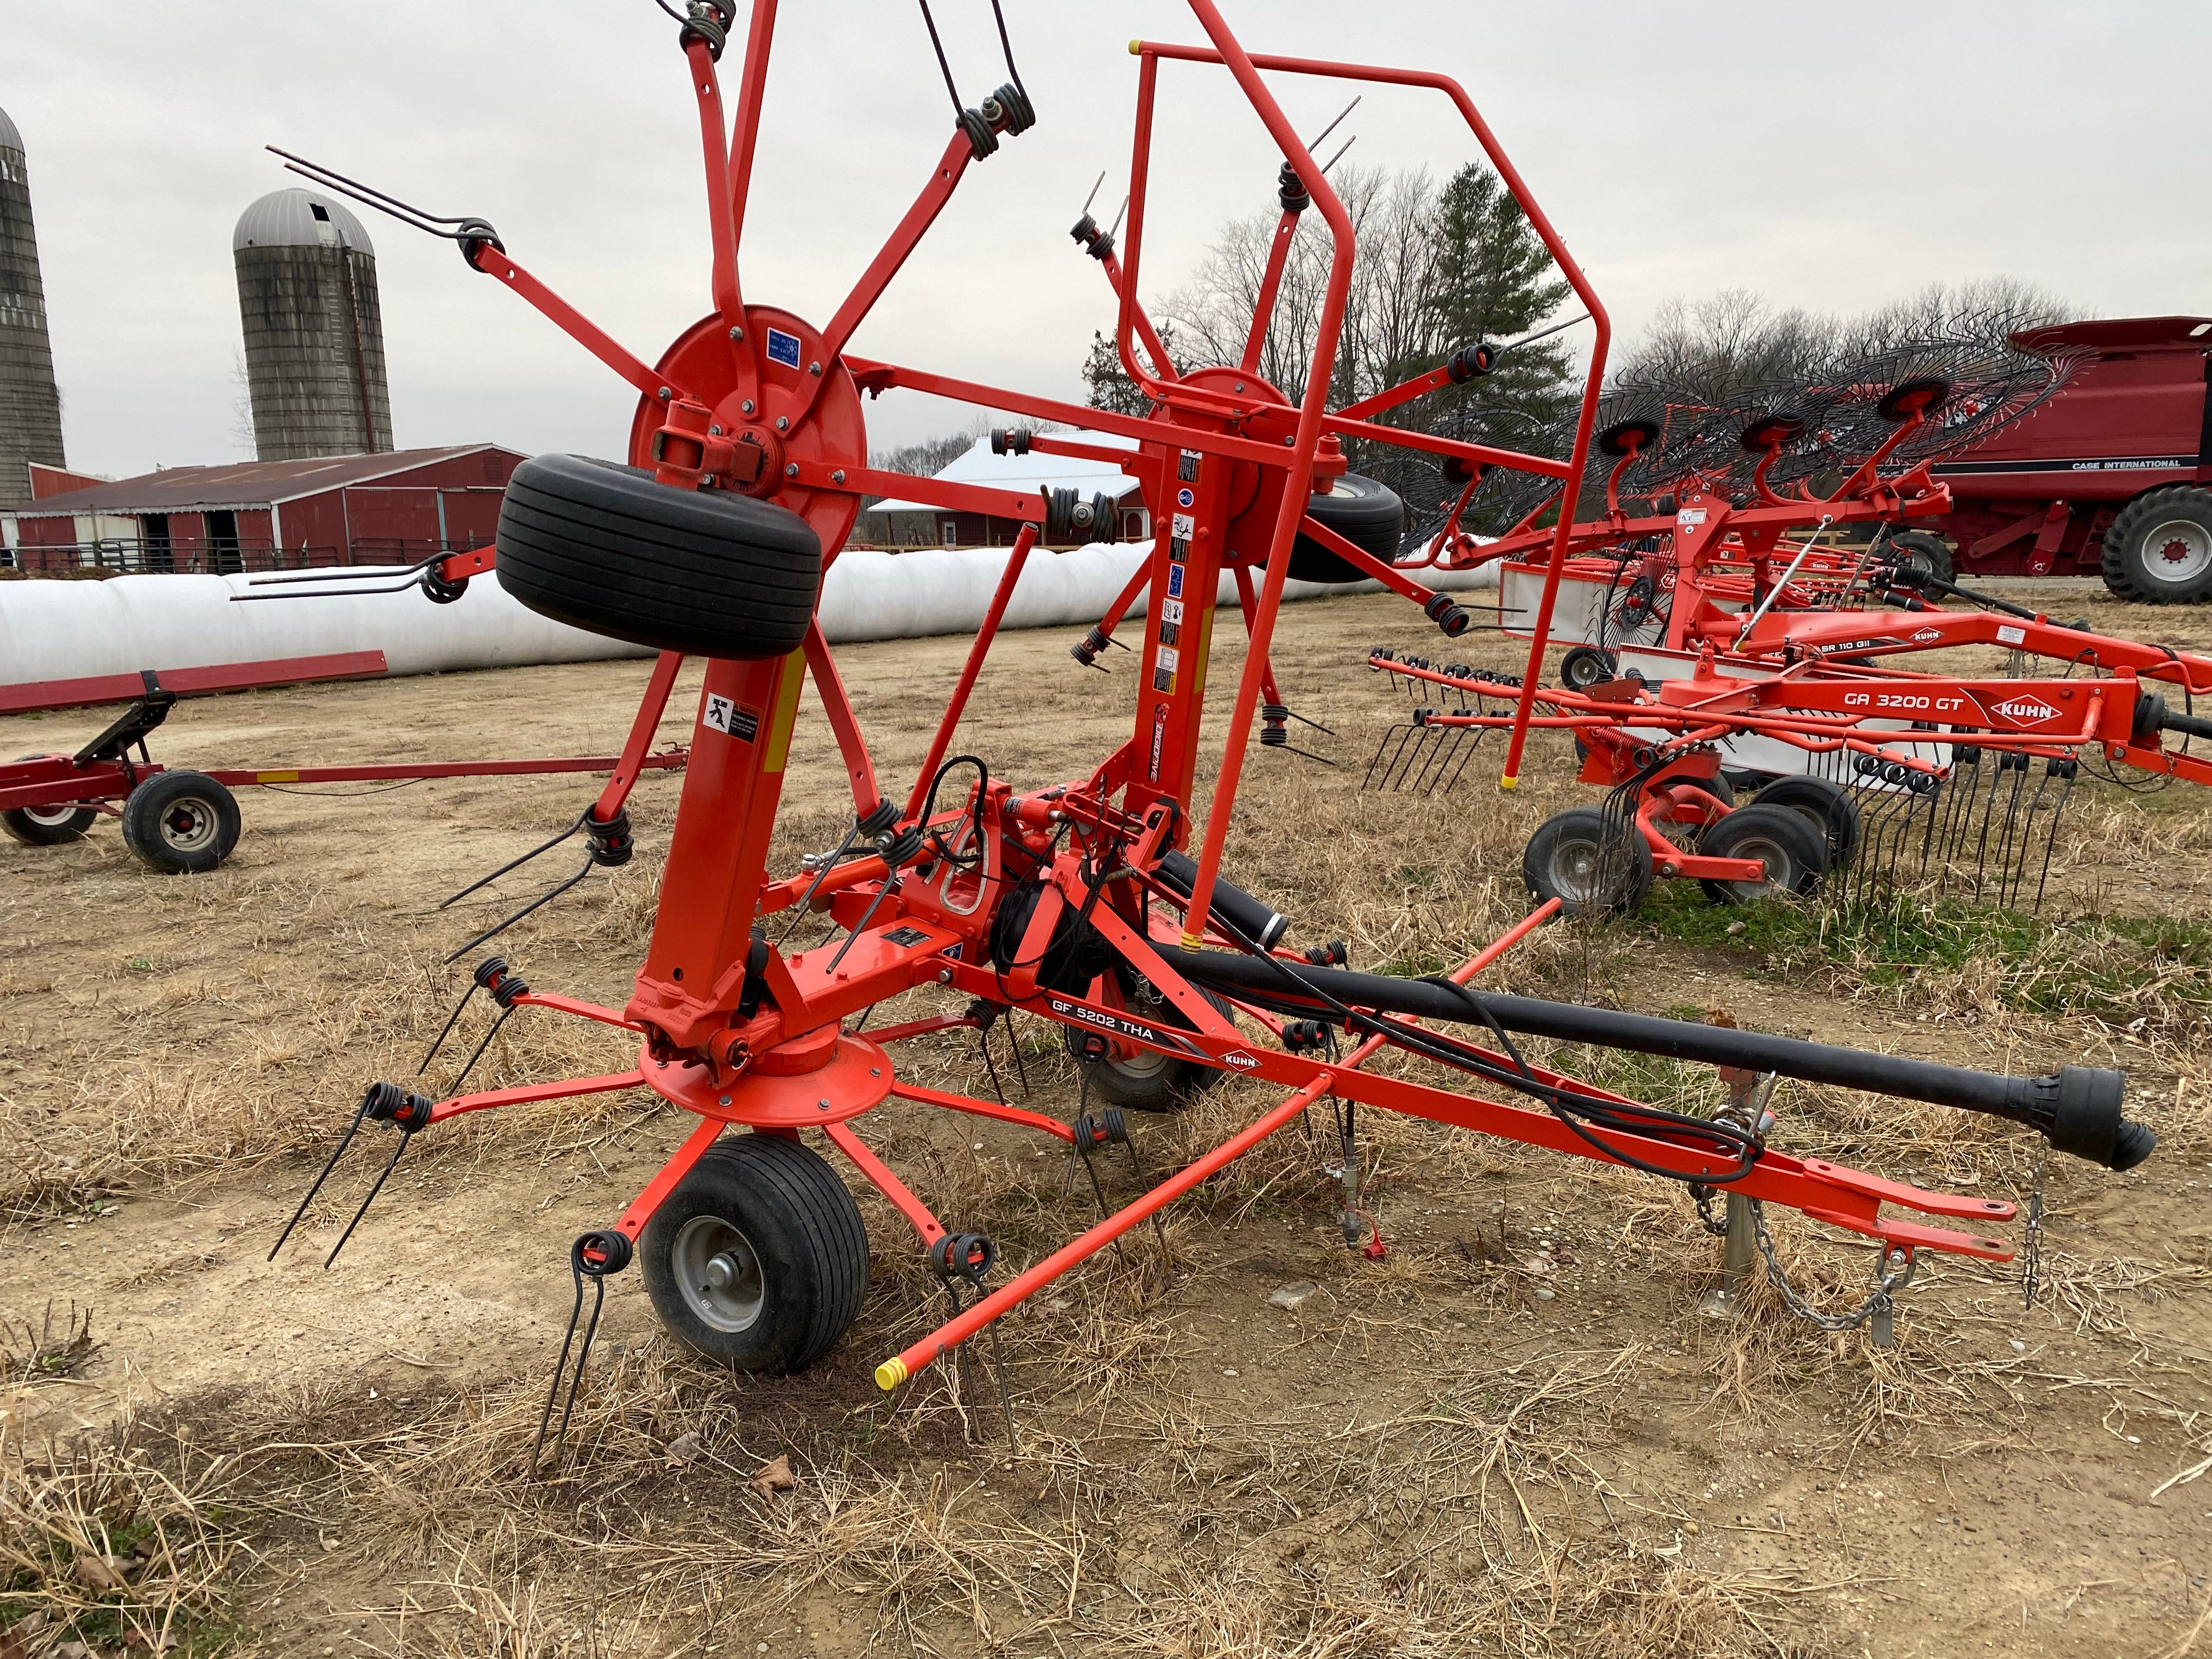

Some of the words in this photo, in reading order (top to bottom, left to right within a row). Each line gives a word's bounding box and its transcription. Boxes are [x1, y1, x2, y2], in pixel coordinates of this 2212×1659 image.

[2104, 460, 2181, 469] INTERNATIONAL
[1915, 632, 1939, 641] KUHN
[1821, 644, 1836, 652] SR
[1839, 642, 1853, 650] 110
[1844, 693, 1870, 706] GA
[1876, 694, 1929, 708] 3200
[1936, 698, 1964, 710] GT
[2001, 703, 2052, 718] KUHN
[1150, 721, 1164, 784] DIGIDRIVE
[1052, 1000, 1072, 1012] GF
[1076, 1007, 1115, 1028] 5202
[1121, 1020, 1154, 1040] THA
[1226, 1055, 1255, 1067] KUHN
